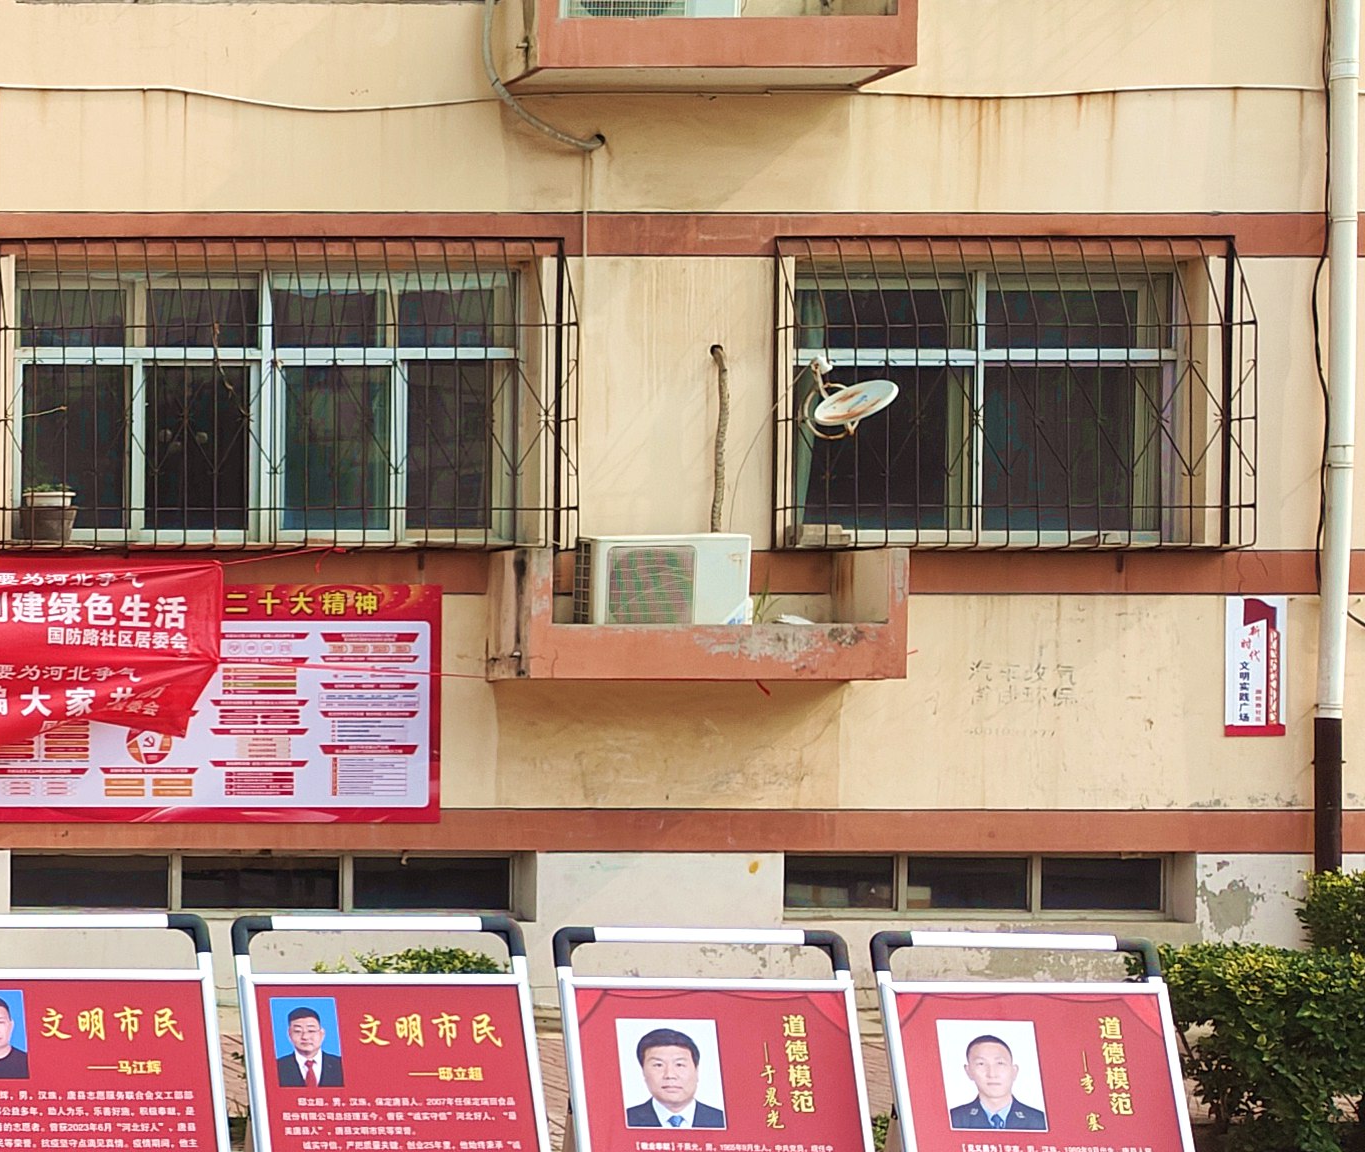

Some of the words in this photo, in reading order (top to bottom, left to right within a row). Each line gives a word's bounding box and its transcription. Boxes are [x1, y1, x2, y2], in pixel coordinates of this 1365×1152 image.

[225, 592, 378, 615] 二十大精神
[47, 627, 189, 650] 国防路社区居委会
[40, 1006, 184, 1041] 文明市民
[359, 1012, 503, 1048] 文明市民
[782, 1014, 815, 1113] 道德模范
[1098, 1016, 1133, 1115] 道德模范
